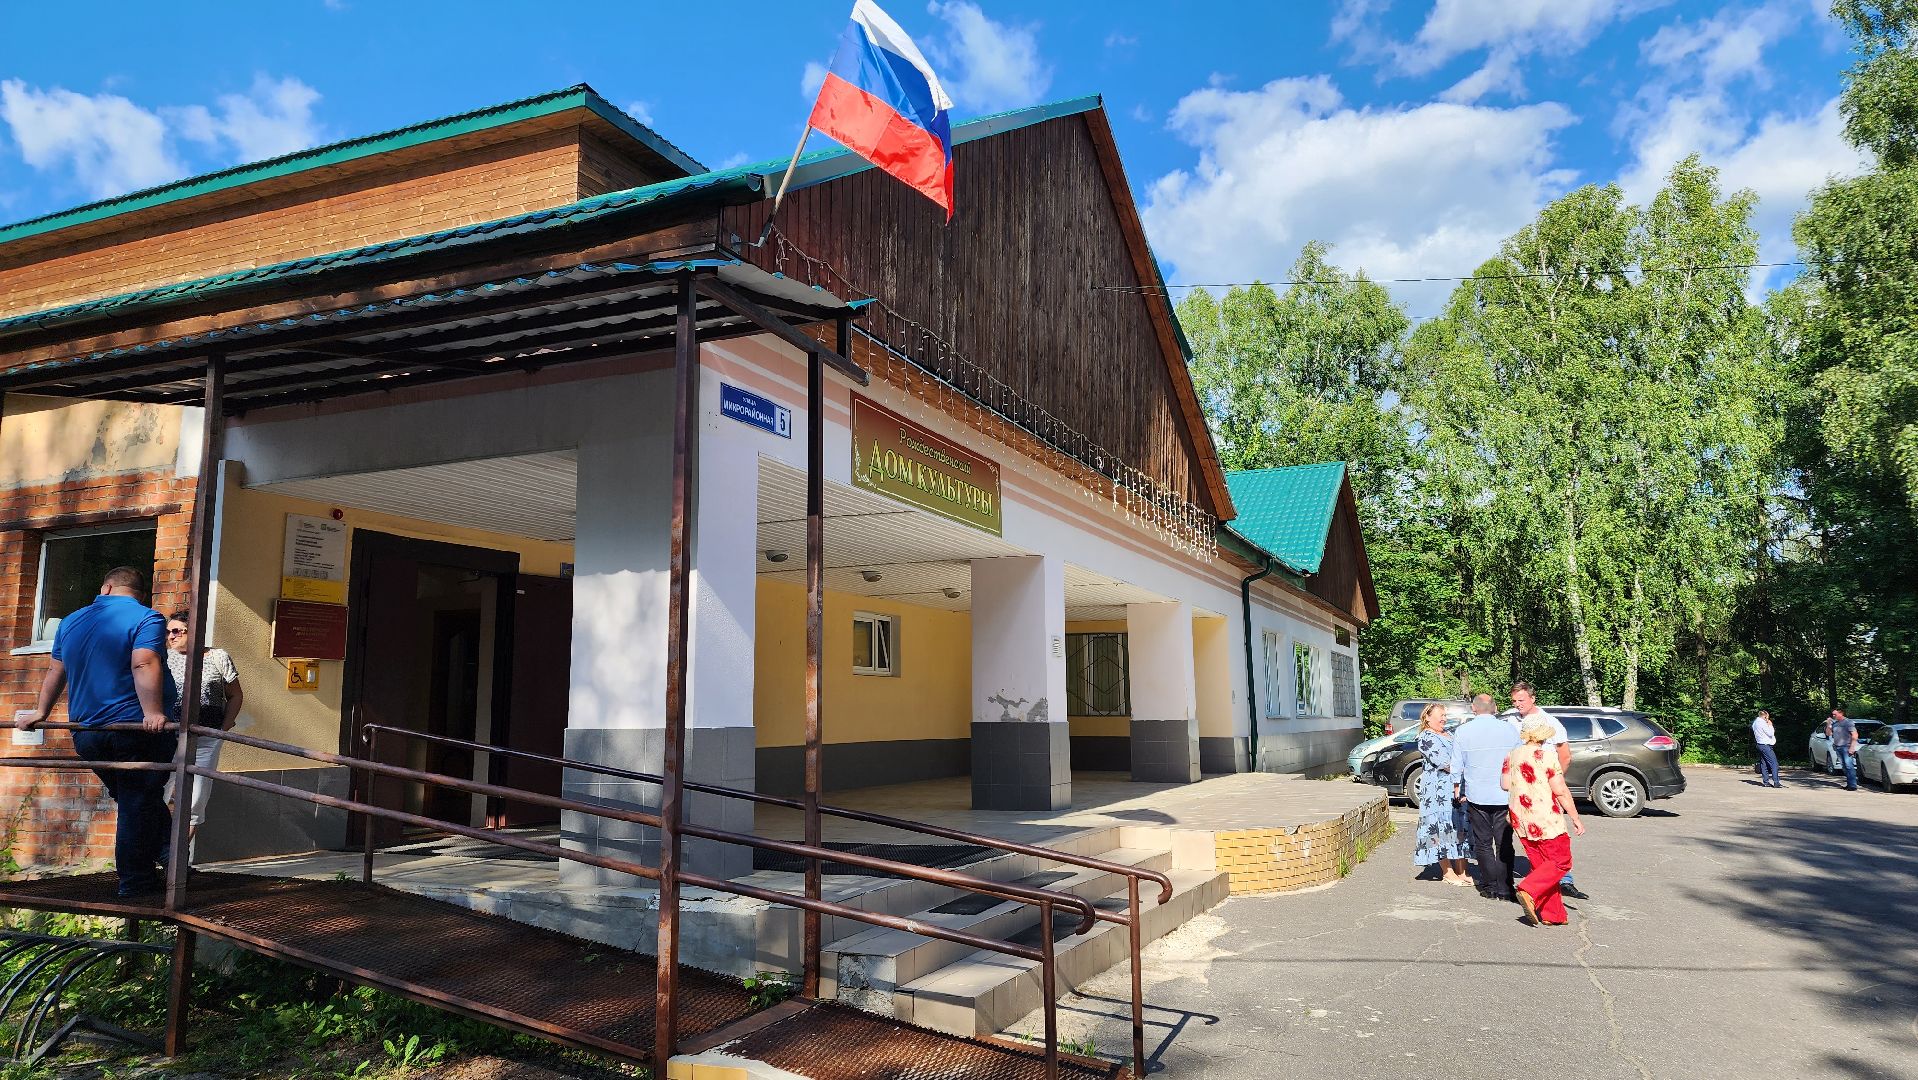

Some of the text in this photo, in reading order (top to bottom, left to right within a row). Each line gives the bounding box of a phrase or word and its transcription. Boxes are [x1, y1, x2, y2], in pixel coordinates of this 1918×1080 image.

[723, 398, 786, 432] МИКРОРАЙОННАЯ 5
[899, 427, 971, 475] Рождественский
[869, 438, 994, 517] ДОМ КУЛЬТУРЫ
